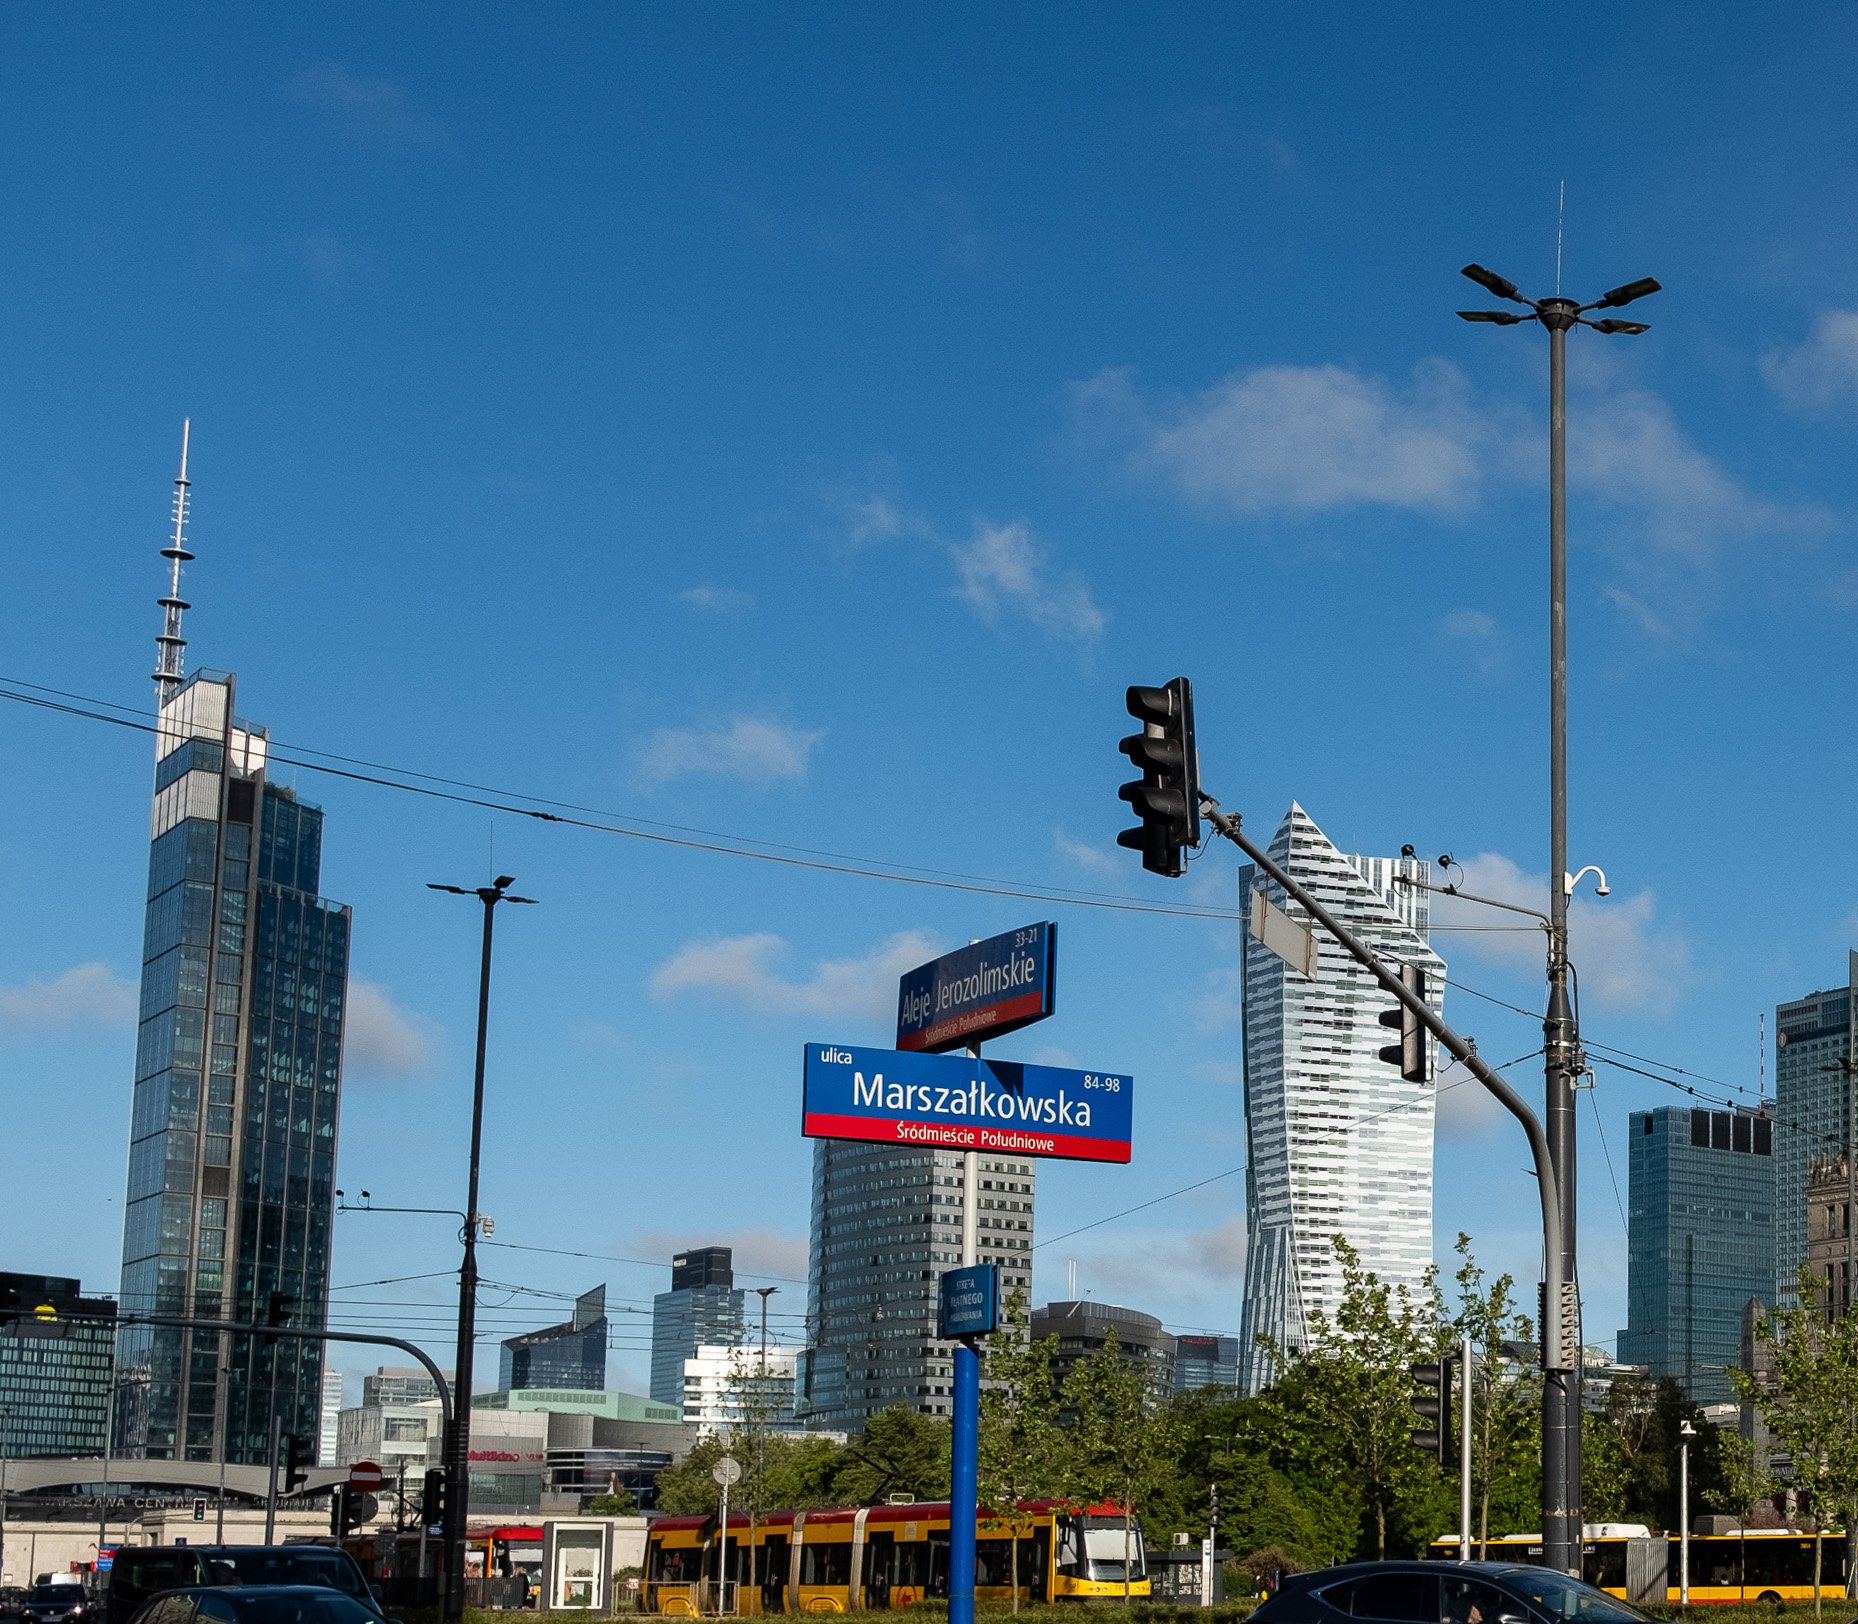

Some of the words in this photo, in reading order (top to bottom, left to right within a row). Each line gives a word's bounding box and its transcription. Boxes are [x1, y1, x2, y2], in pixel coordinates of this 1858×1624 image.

[1015, 928, 1038, 948] 33-21
[901, 987, 930, 1029] Aleje
[935, 951, 1036, 1013] Jerozolimskie
[925, 1023, 959, 1044] Śródmieście
[959, 1010, 997, 1032] Południowe
[820, 1048, 852, 1065] ulica
[853, 1071, 1092, 1127] Marszałkowska
[1084, 1074, 1121, 1093] 84-98
[896, 1120, 975, 1145] Śródmieście
[981, 1130, 1055, 1152] Południowe
